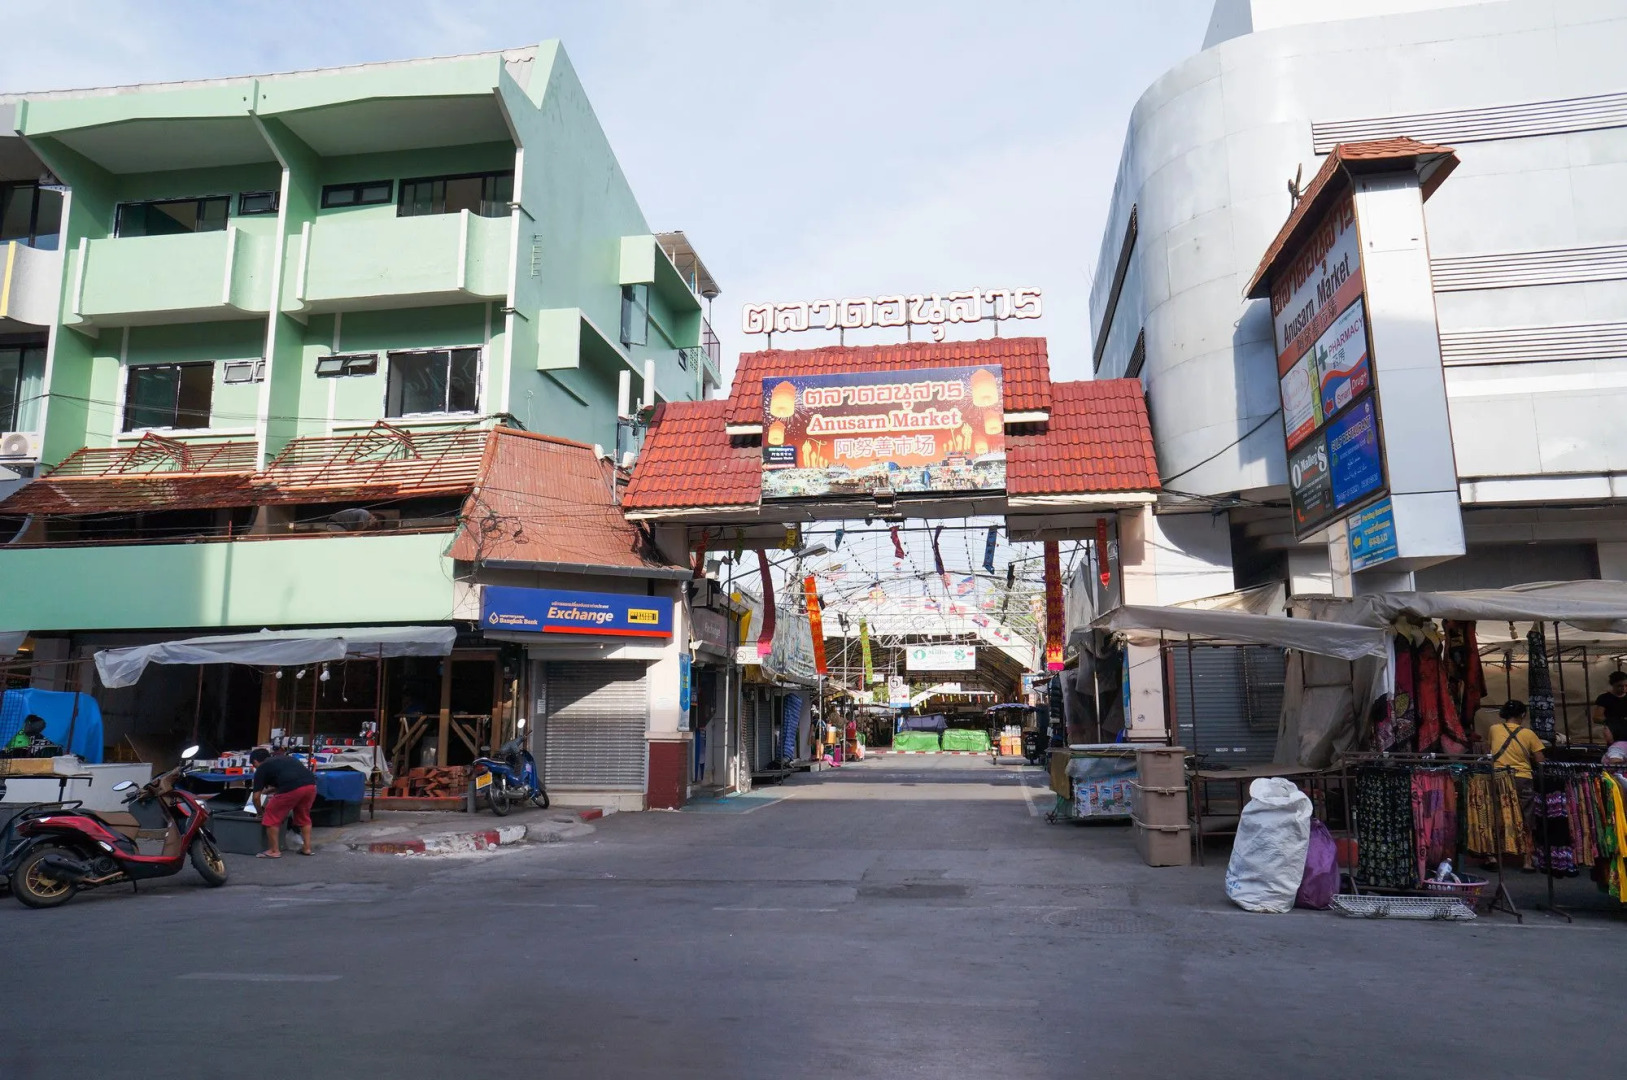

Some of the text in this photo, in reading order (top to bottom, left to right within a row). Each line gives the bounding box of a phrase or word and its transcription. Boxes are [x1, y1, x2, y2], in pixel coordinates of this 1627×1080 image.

[1284, 298, 1315, 348] Anusarn
[1316, 252, 1350, 309] Market
[742, 286, 1042, 342] ตลาดอนุสาร
[1328, 316, 1363, 355] PHARMACY
[803, 382, 964, 409] ตลาดอนุสาร
[810, 411, 960, 432] Anusarn Market
[834, 435, 936, 459] 阿努善市场
[547, 606, 614, 625] Exchange
